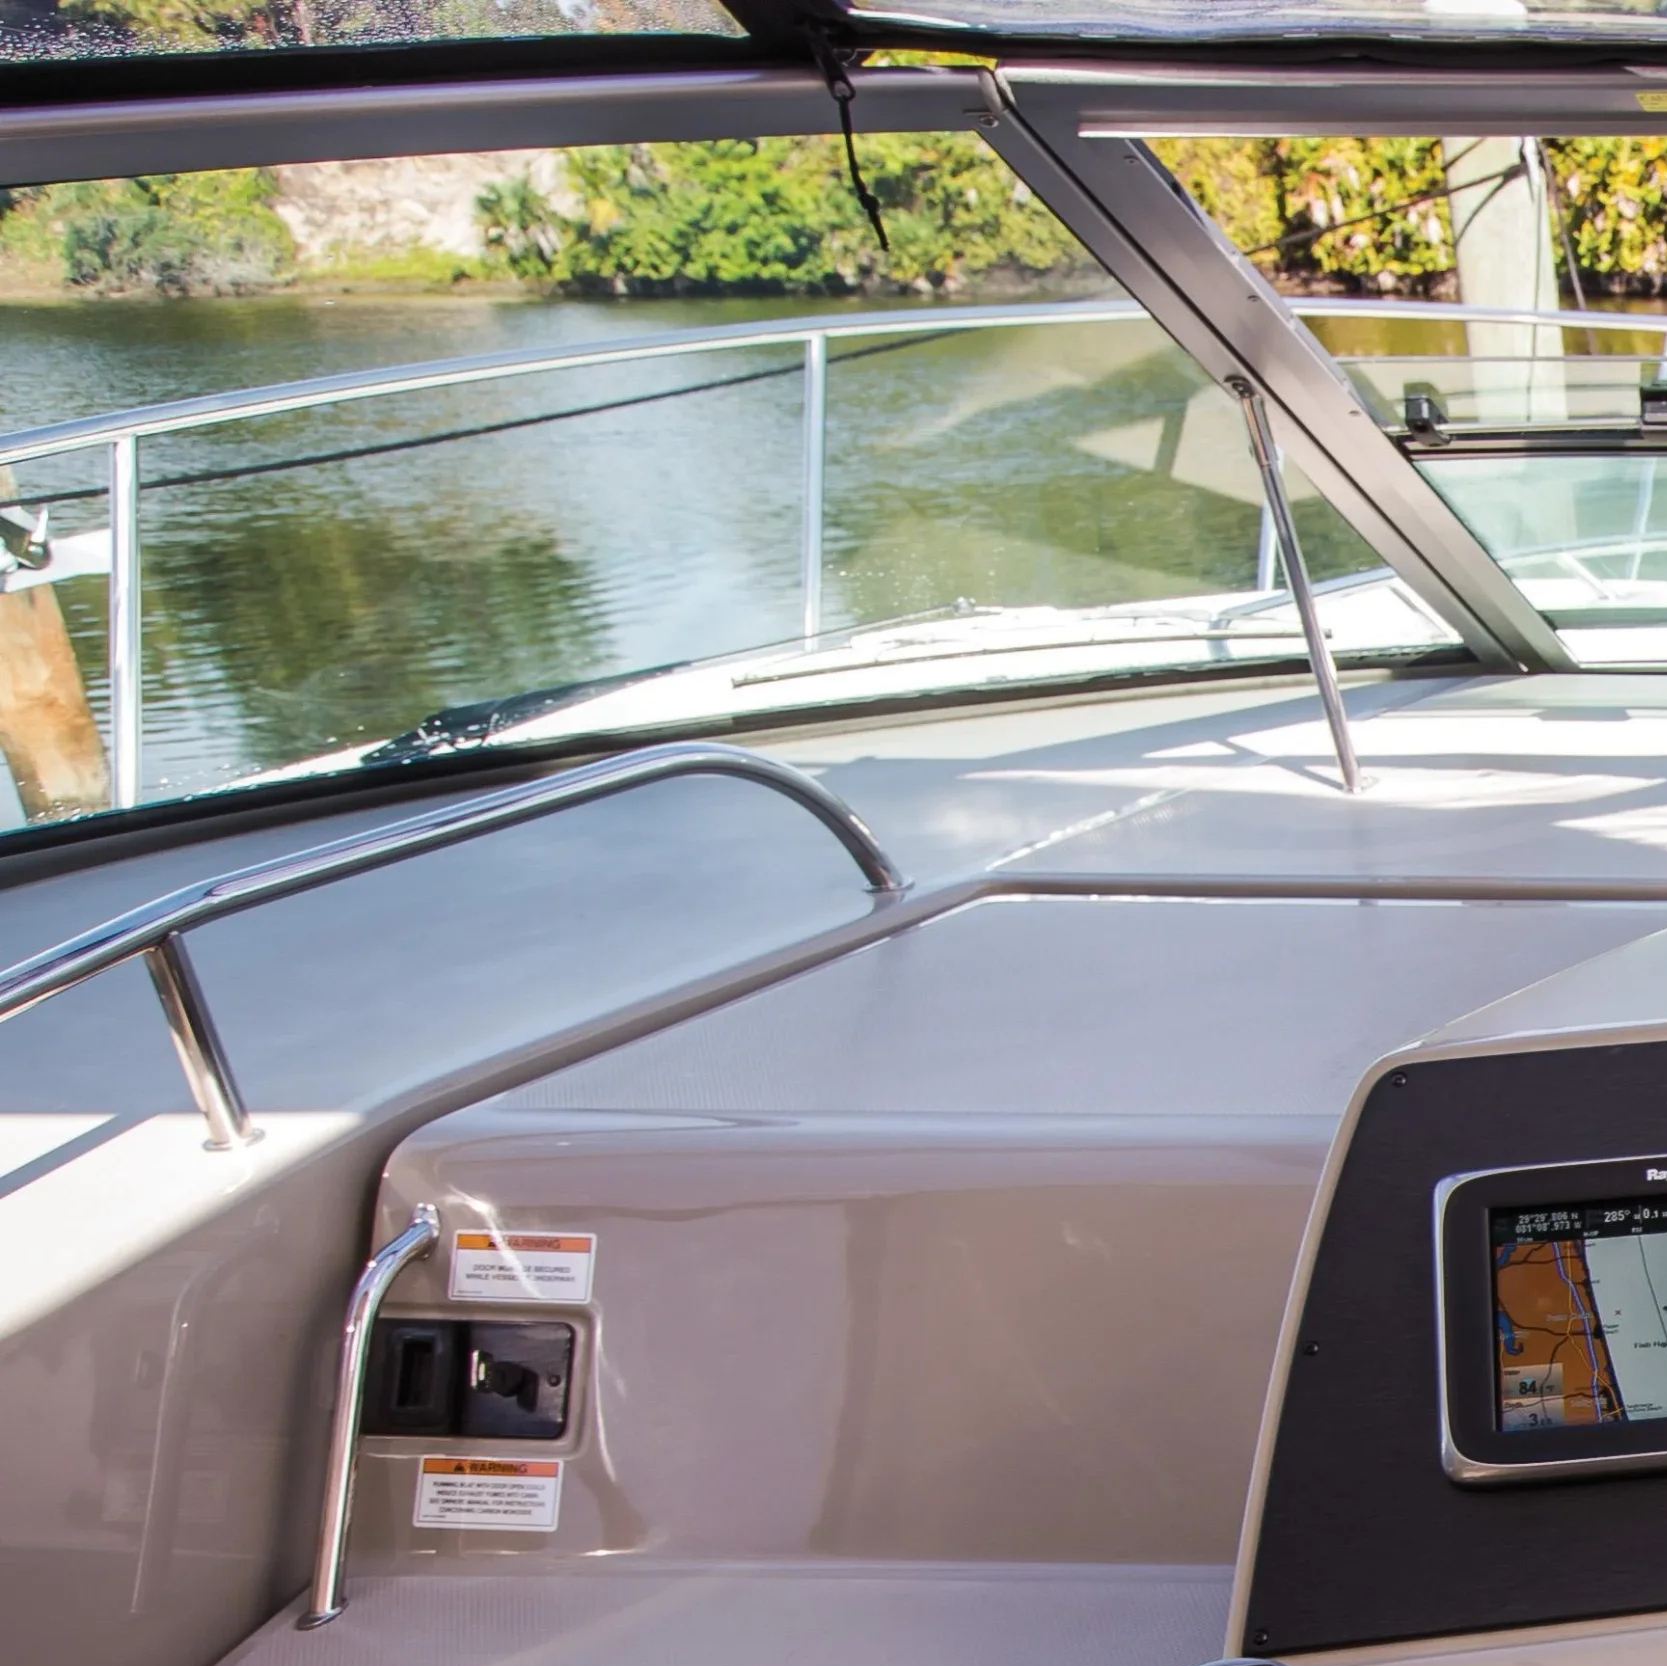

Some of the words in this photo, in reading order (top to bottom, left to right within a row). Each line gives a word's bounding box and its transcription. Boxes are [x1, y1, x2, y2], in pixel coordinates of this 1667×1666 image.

[1604, 1210, 1631, 1222] 285°
[1642, 1208, 1659, 1219] 0.1
[468, 1463, 528, 1474] WARNING
